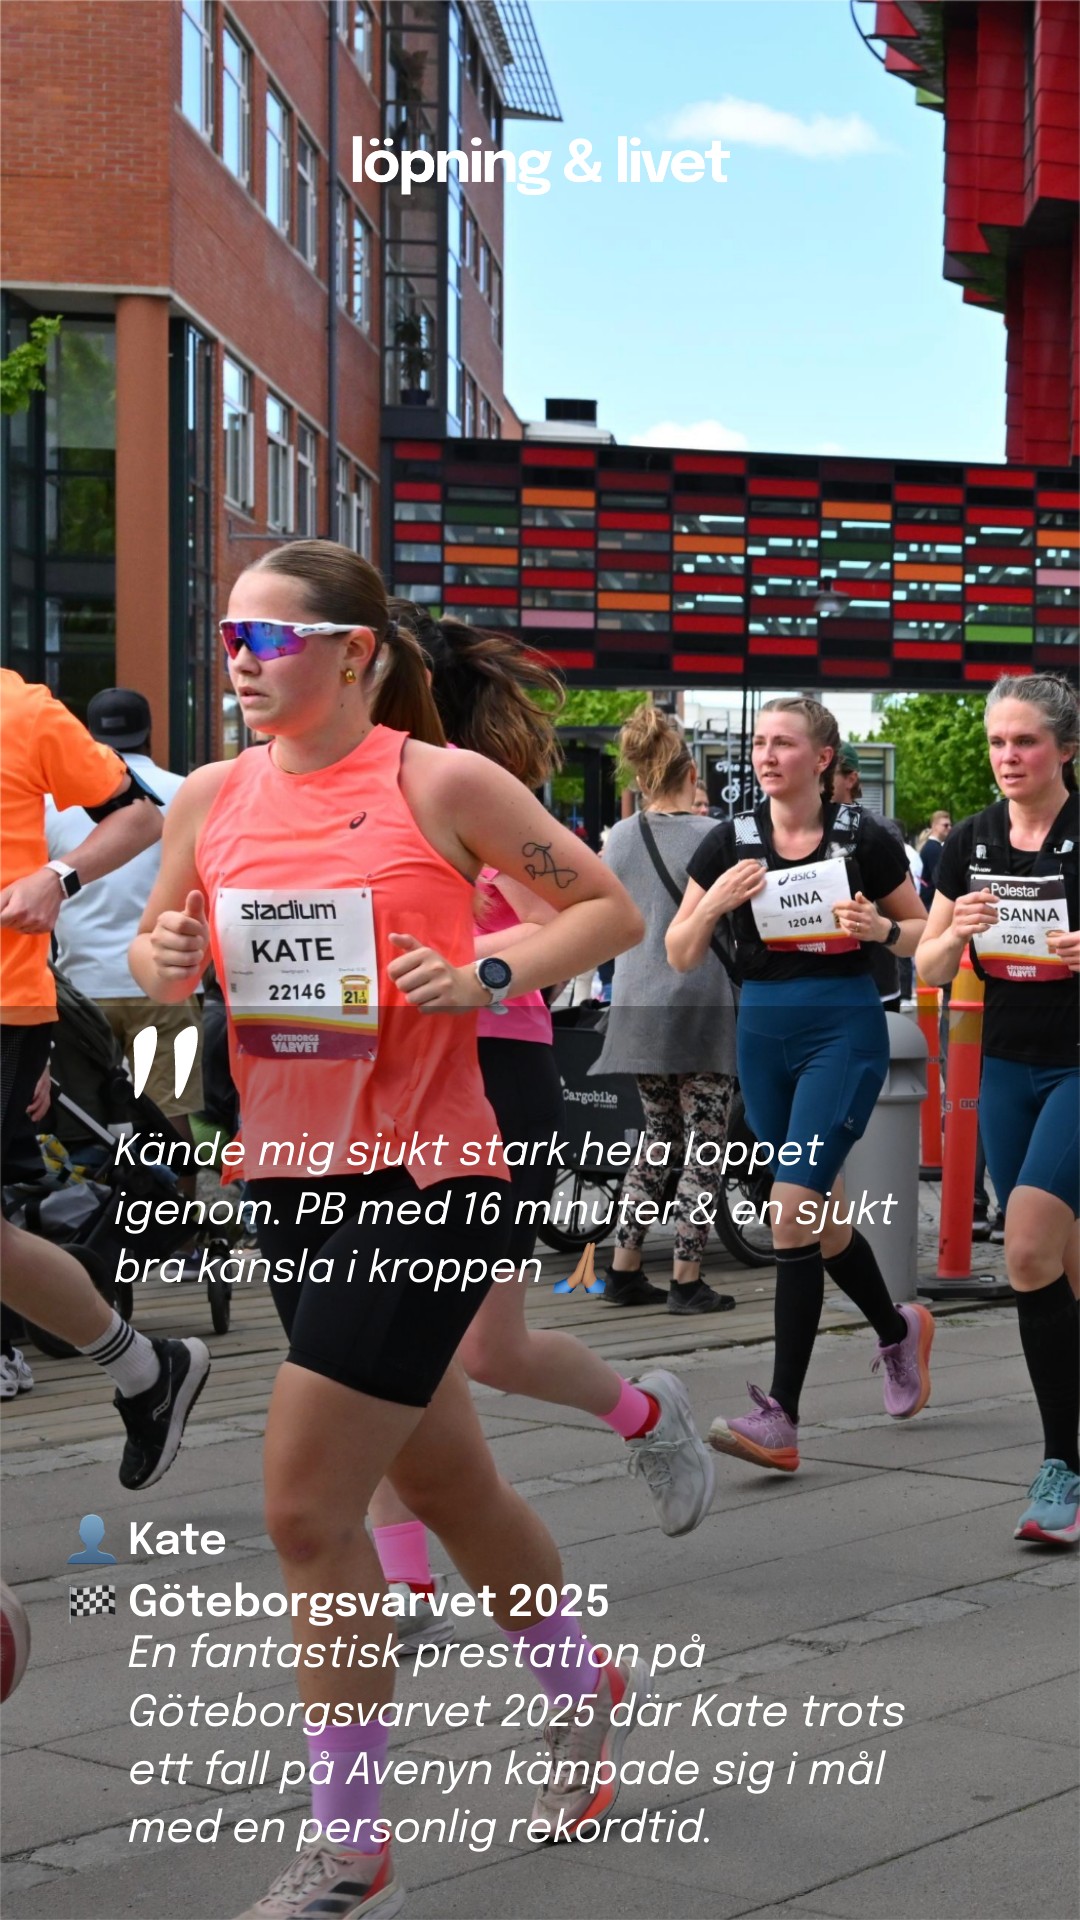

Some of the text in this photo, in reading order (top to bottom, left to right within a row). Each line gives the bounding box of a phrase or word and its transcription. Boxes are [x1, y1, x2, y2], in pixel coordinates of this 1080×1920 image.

[790, 870, 817, 882] asics
[990, 882, 1040, 898] Polestar
[780, 890, 823, 909] NINA
[241, 899, 337, 920] stadium
[995, 907, 1060, 922] SANNA
[788, 914, 823, 929] 12044
[1001, 934, 1036, 945] 12046
[251, 937, 335, 964] KATE
[268, 983, 326, 1001] 22146
[344, 991, 358, 1004] 21
[271, 1033, 320, 1042] GÖTEBORGS
[272, 1041, 320, 1053] VARVET
[562, 1089, 618, 1106] Cargobike
